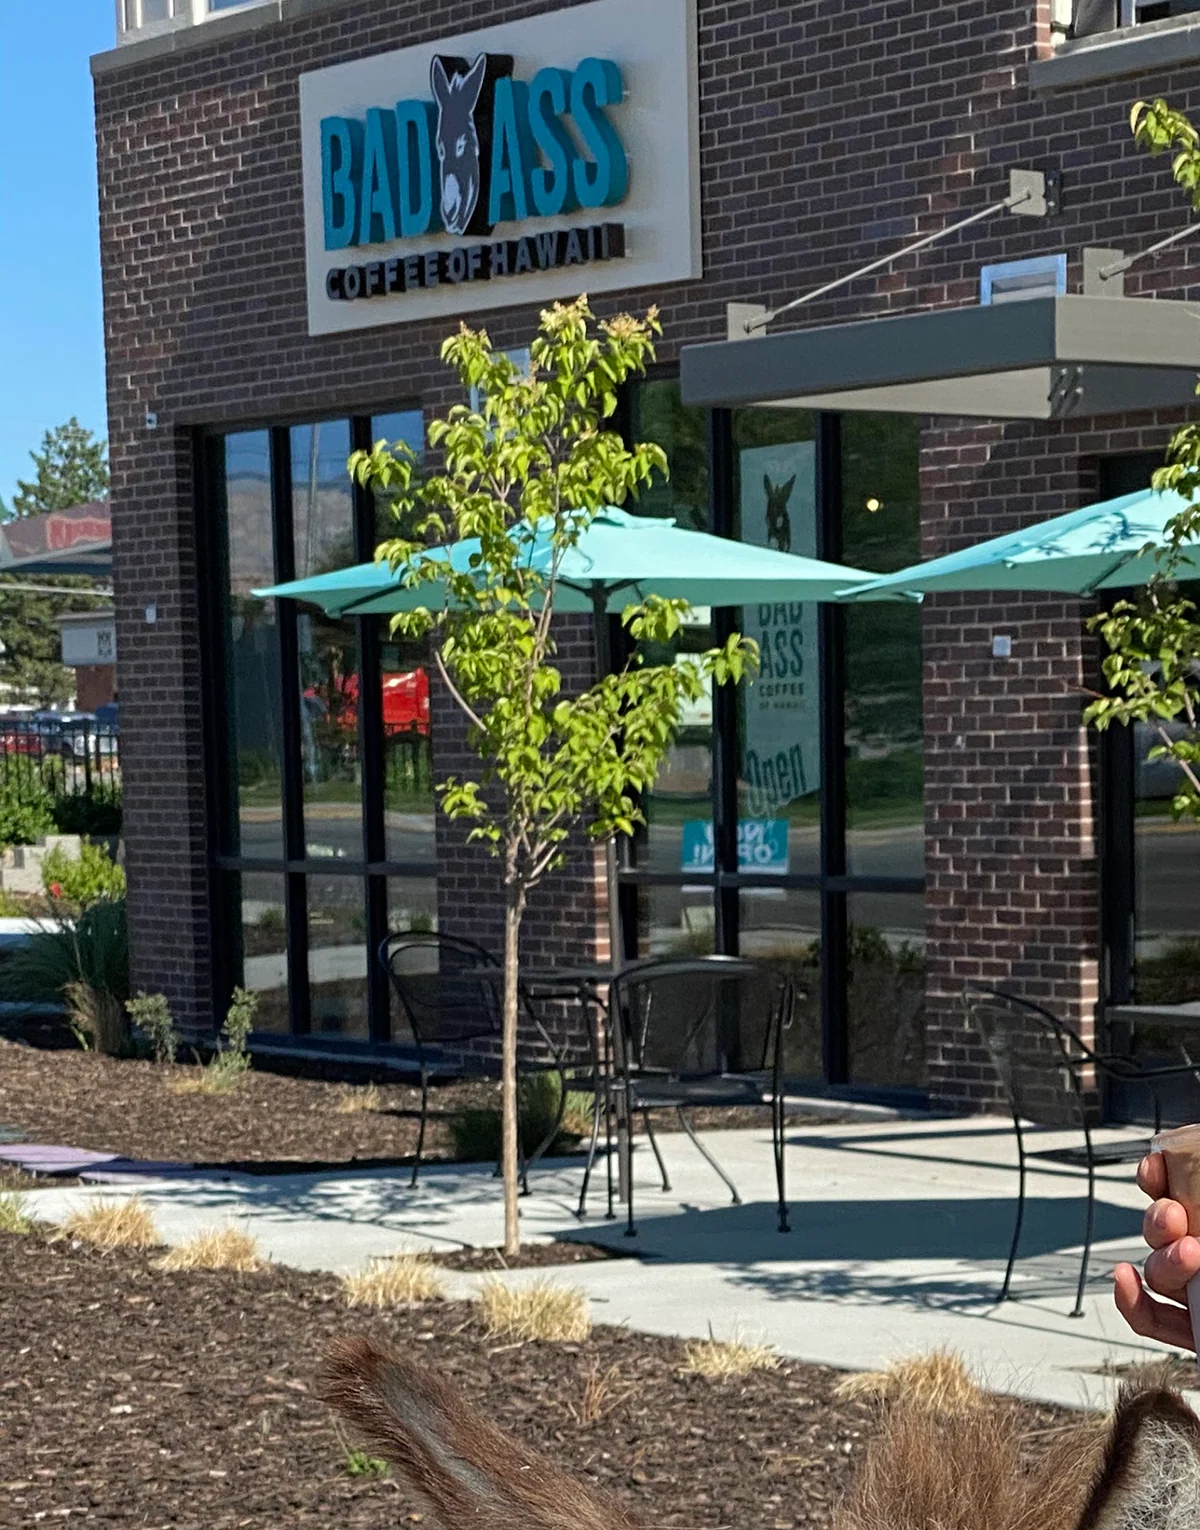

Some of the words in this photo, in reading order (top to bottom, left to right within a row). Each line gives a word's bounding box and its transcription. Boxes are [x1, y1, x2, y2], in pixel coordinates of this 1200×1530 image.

[320, 99, 440, 251] BAD
[489, 57, 628, 223] ASS
[326, 252, 442, 300] COFFEE
[446, 246, 486, 283] OF
[489, 224, 620, 276] HAWAII
[760, 628, 803, 678] ASS
